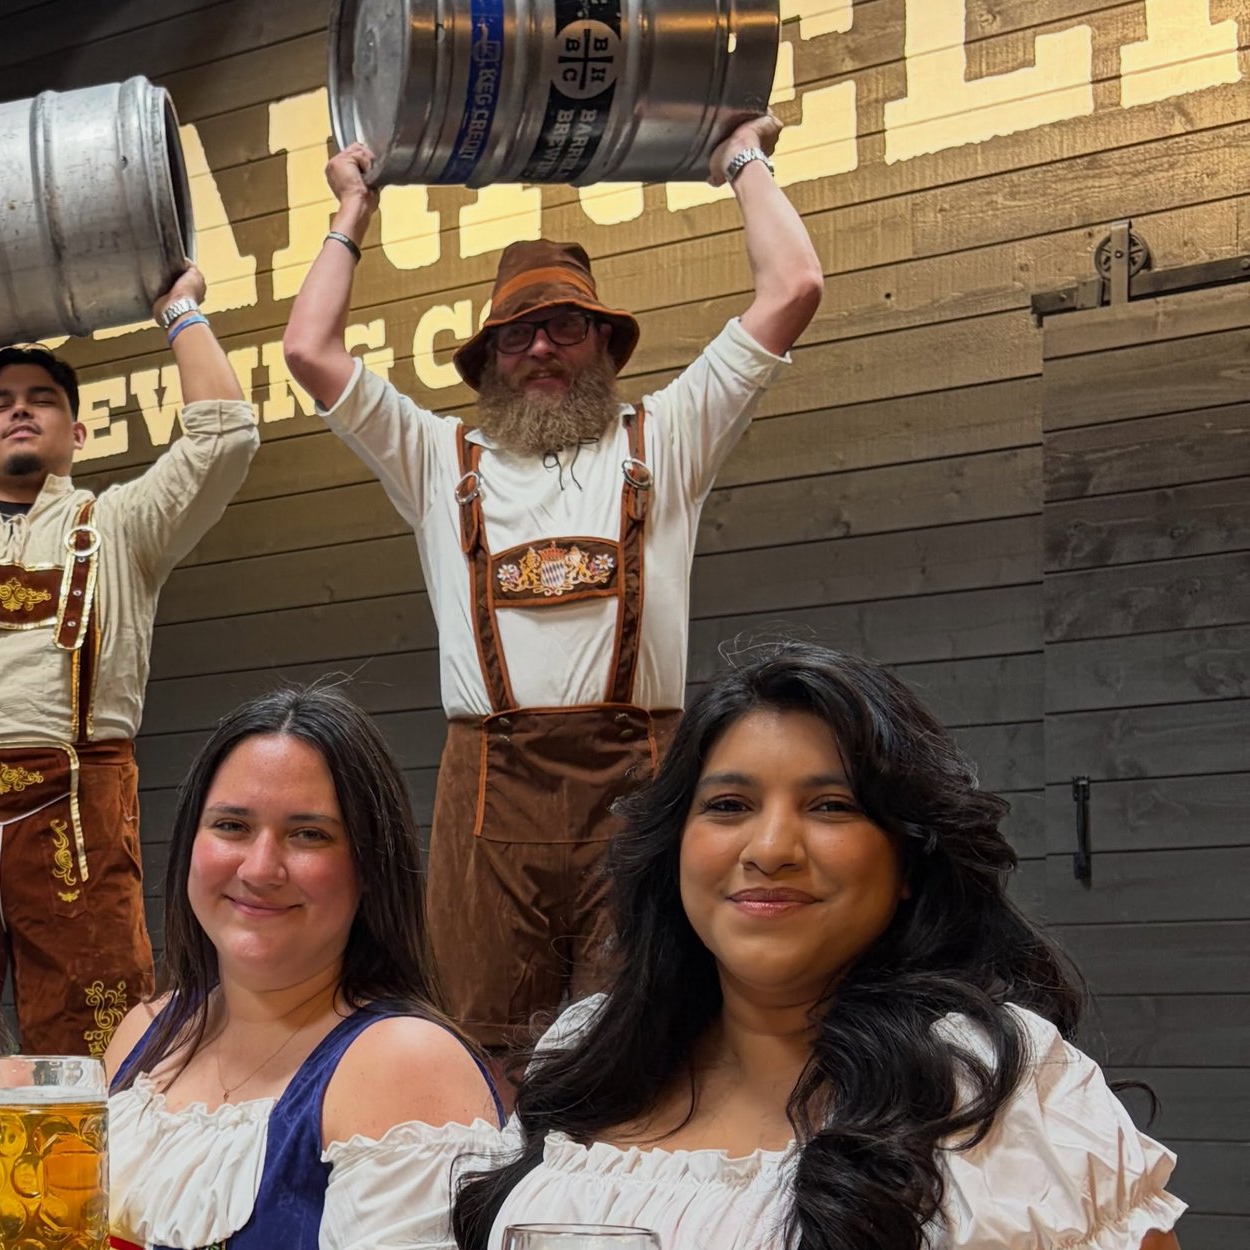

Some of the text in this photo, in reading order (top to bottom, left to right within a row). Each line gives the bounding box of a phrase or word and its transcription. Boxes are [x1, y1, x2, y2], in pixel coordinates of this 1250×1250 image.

[458, 69, 498, 161] KEG CREDIT
[557, 109, 599, 177] BARREL
